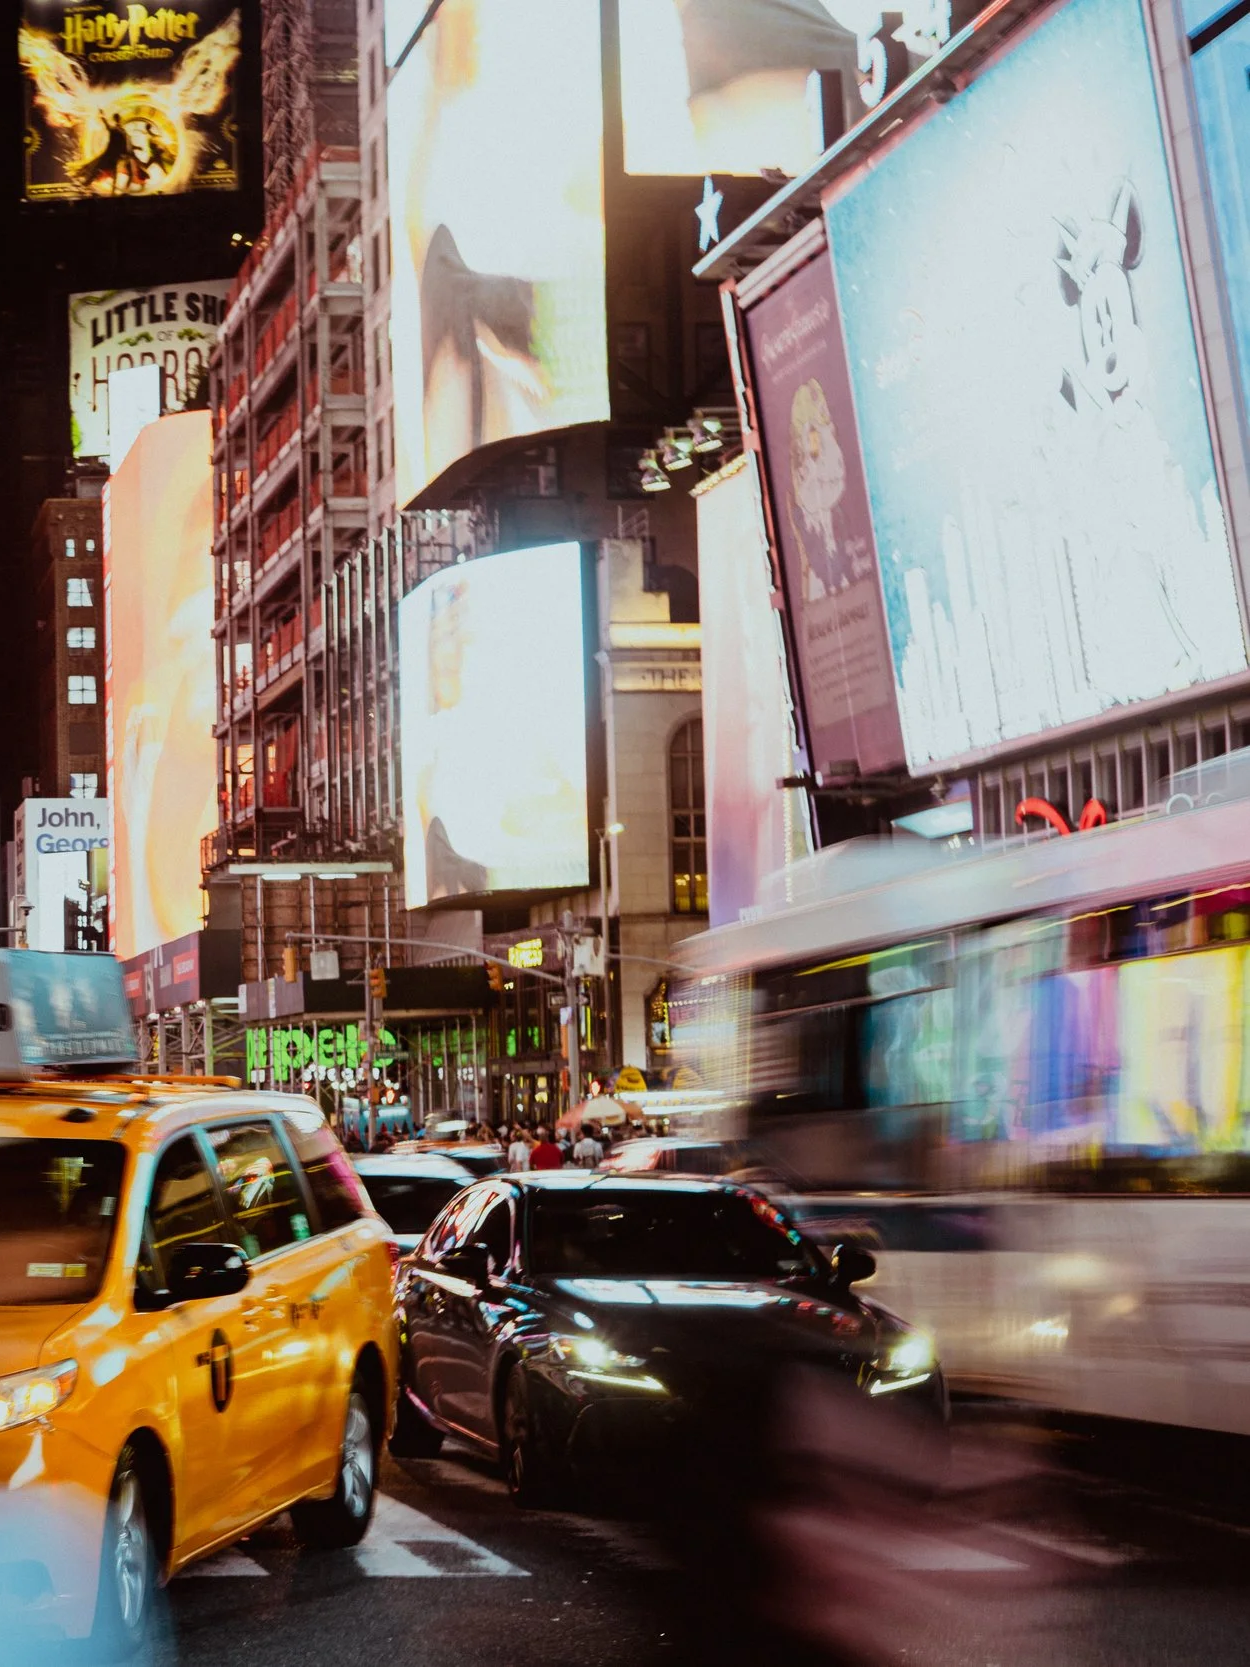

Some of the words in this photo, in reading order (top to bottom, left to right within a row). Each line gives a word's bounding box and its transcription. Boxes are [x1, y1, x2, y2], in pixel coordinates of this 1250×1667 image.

[61, 12, 129, 54] Harry
[126, 3, 199, 46] Potter
[91, 292, 178, 348] LITTLE
[156, 331, 174, 342] OF
[646, 668, 689, 687] THE
[37, 808, 101, 829] John,
